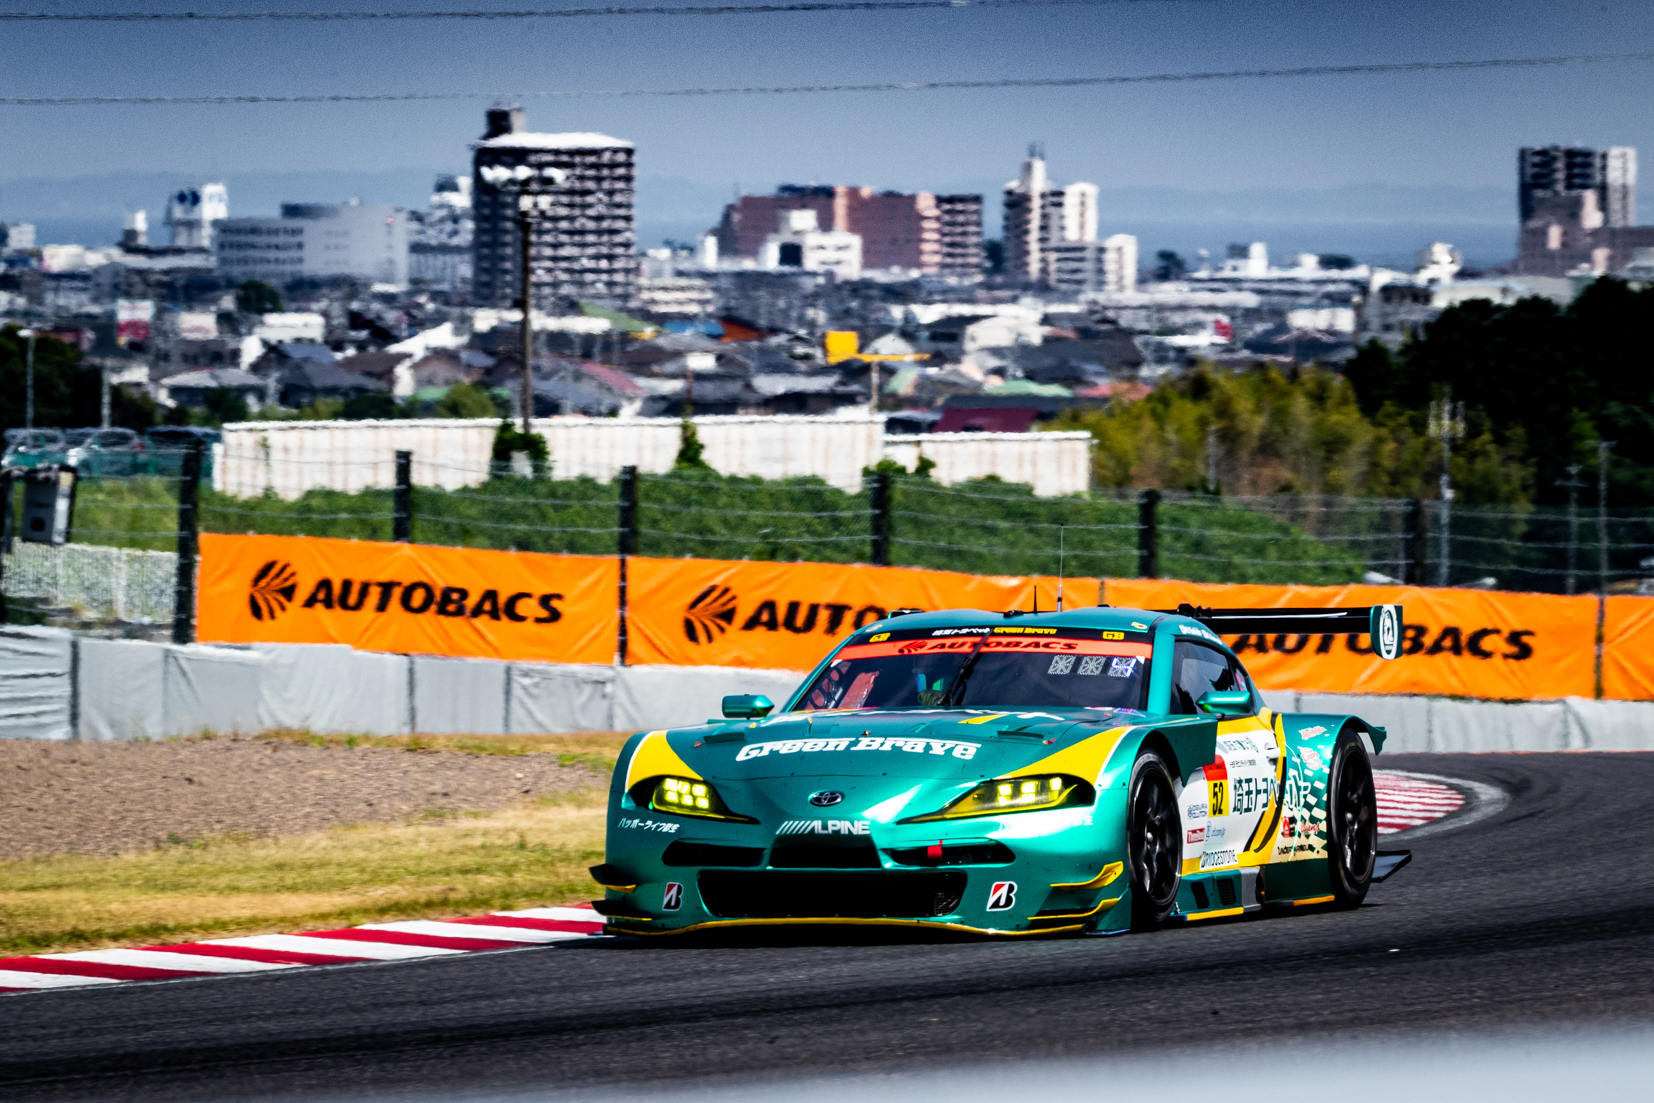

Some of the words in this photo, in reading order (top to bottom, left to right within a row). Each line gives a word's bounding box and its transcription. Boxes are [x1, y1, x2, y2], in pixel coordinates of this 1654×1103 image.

[302, 577, 564, 624] AUTOBACS
[1102, 631, 1125, 640] GB
[735, 738, 856, 761] Green
[850, 737, 982, 760] Brave
[1212, 782, 1224, 816] 52
[801, 820, 871, 835] ALPINE
